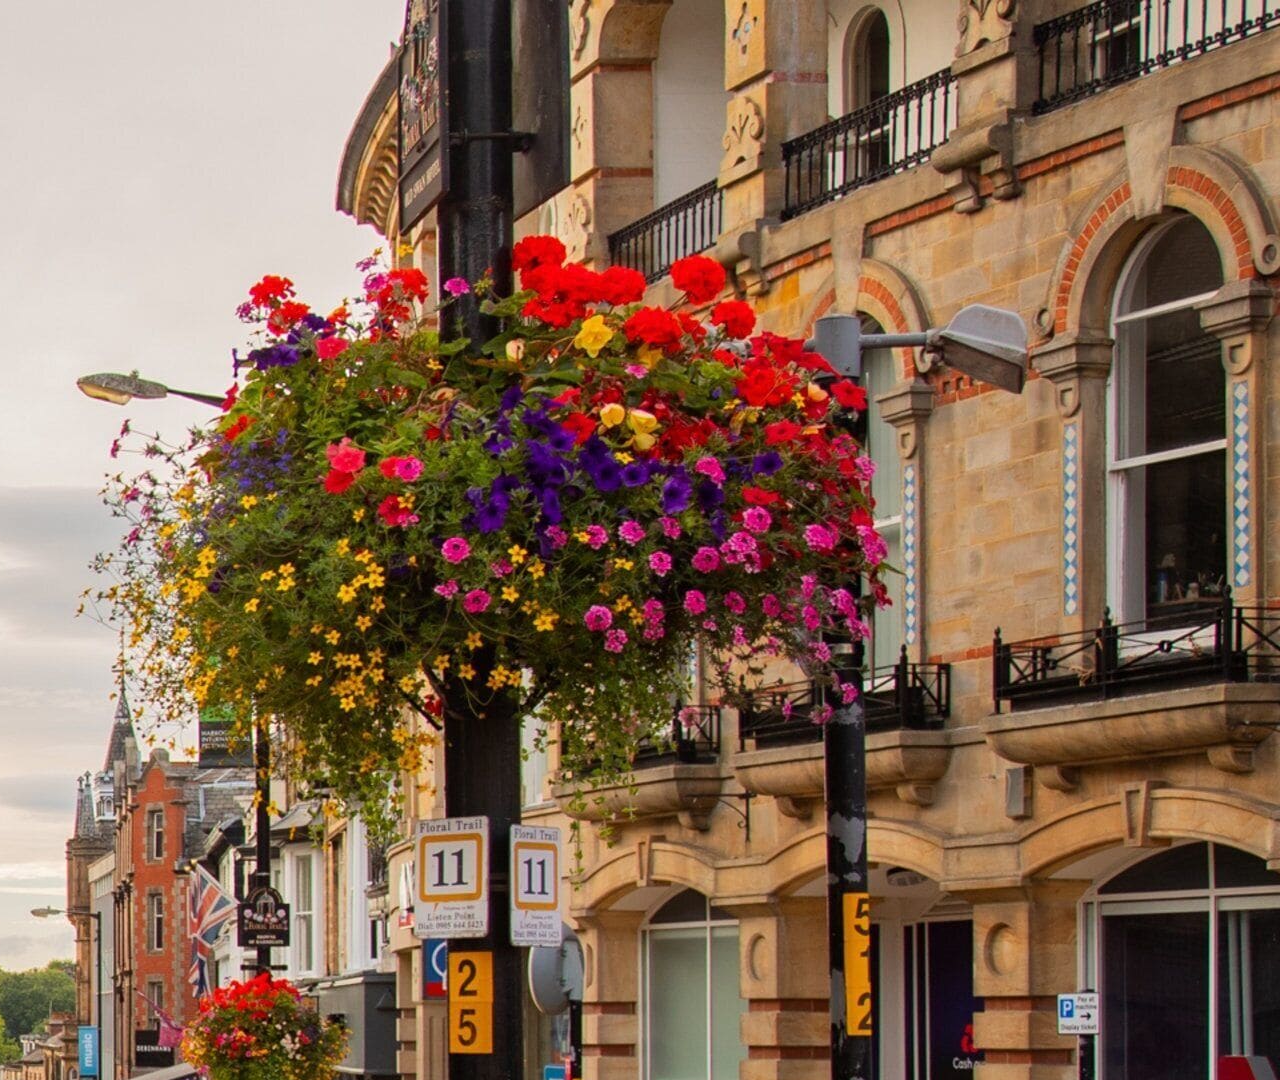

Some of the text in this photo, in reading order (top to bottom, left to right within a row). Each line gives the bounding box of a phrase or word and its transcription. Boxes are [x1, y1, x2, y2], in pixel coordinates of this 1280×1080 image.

[419, 818, 483, 834] Floral Trail
[513, 828, 559, 841] Floral Trail
[432, 847, 469, 887] 11
[523, 857, 550, 896] 11
[427, 911, 475, 922] Listen Point
[457, 959, 479, 998] 2
[457, 1008, 479, 1047] 5
[84, 1033, 93, 1067] music
[136, 1044, 172, 1053] DEBENHAMS
[952, 1056, 973, 1070] Cash
